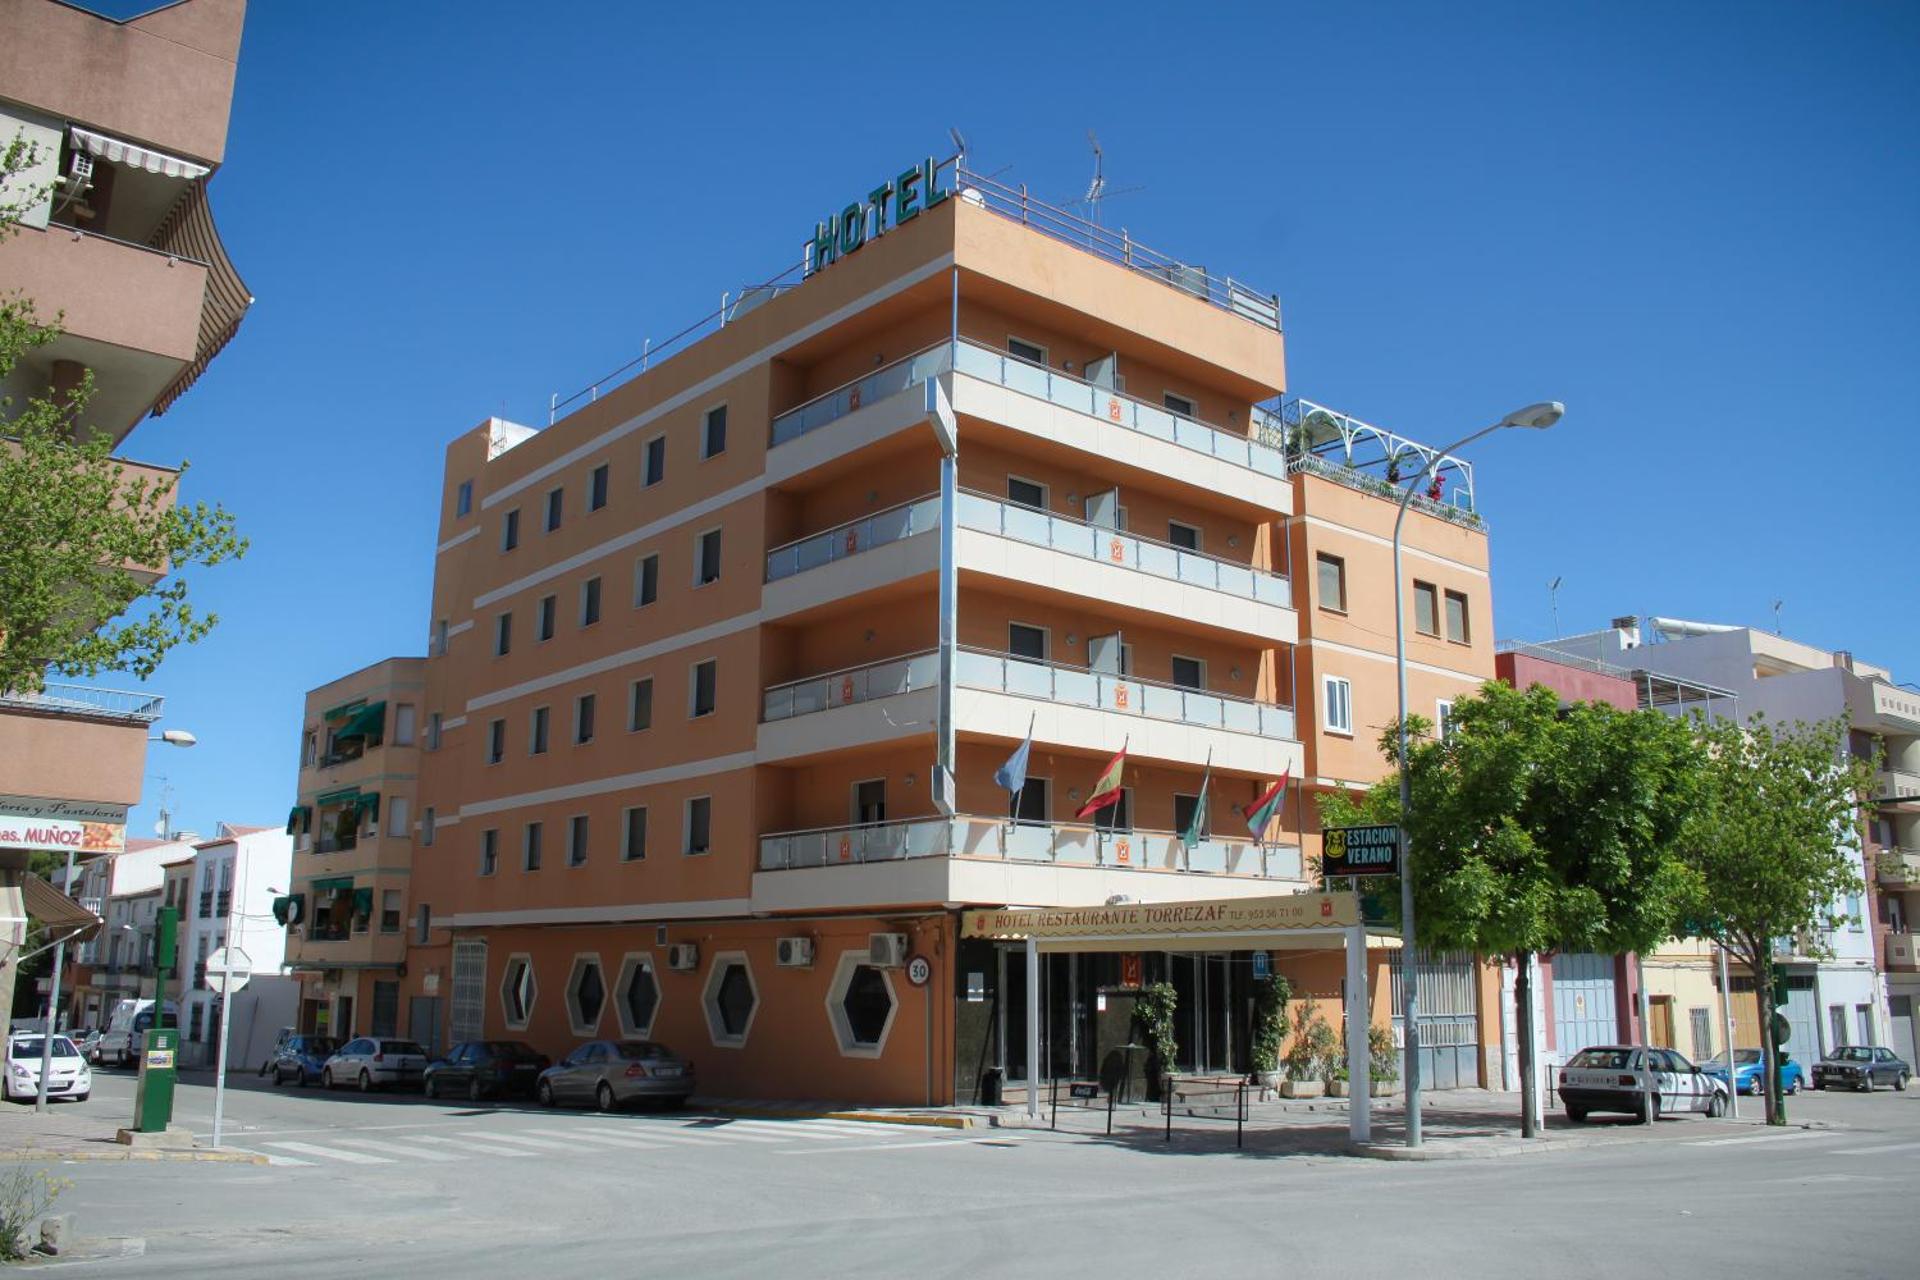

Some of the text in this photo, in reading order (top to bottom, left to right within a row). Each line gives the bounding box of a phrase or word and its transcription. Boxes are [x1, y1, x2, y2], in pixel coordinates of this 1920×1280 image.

[814, 156, 949, 272] HOTEL
[30, 807, 43, 817] y
[24, 825, 80, 845] MUÑOZ
[1346, 827, 1396, 846] ESTACION
[1347, 846, 1393, 865] VERANO
[995, 914, 1034, 929] HOTEL
[1037, 909, 1138, 927] RESTAURANTE
[1144, 904, 1228, 924] TORREZAF
[912, 964, 926, 978] 30
